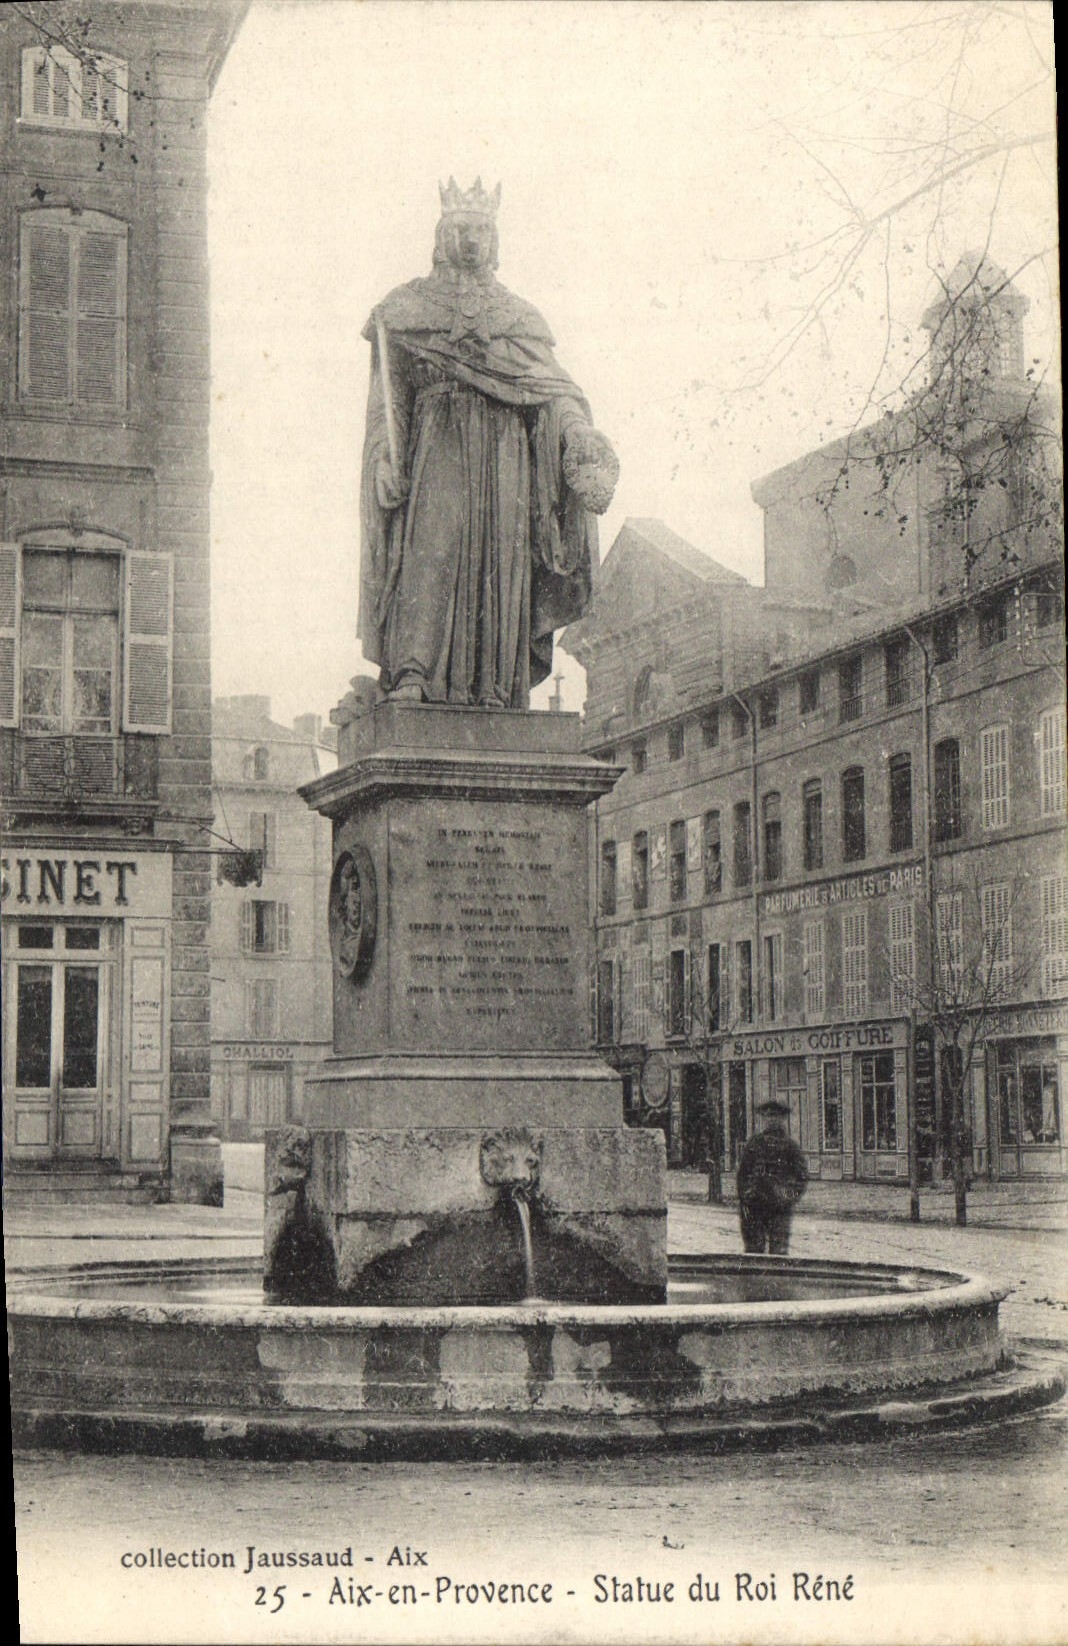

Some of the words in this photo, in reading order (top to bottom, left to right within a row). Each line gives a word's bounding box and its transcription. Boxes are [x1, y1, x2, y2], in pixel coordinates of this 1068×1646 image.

[765, 887, 819, 912] PARFUMERIE
[829, 877, 875, 901] ARTICLES
[889, 866, 922, 892] PARIS
[223, 1046, 294, 1059] CHALLIOL
[733, 1036, 785, 1056] SALON
[808, 1026, 893, 1050] COIFFURE
